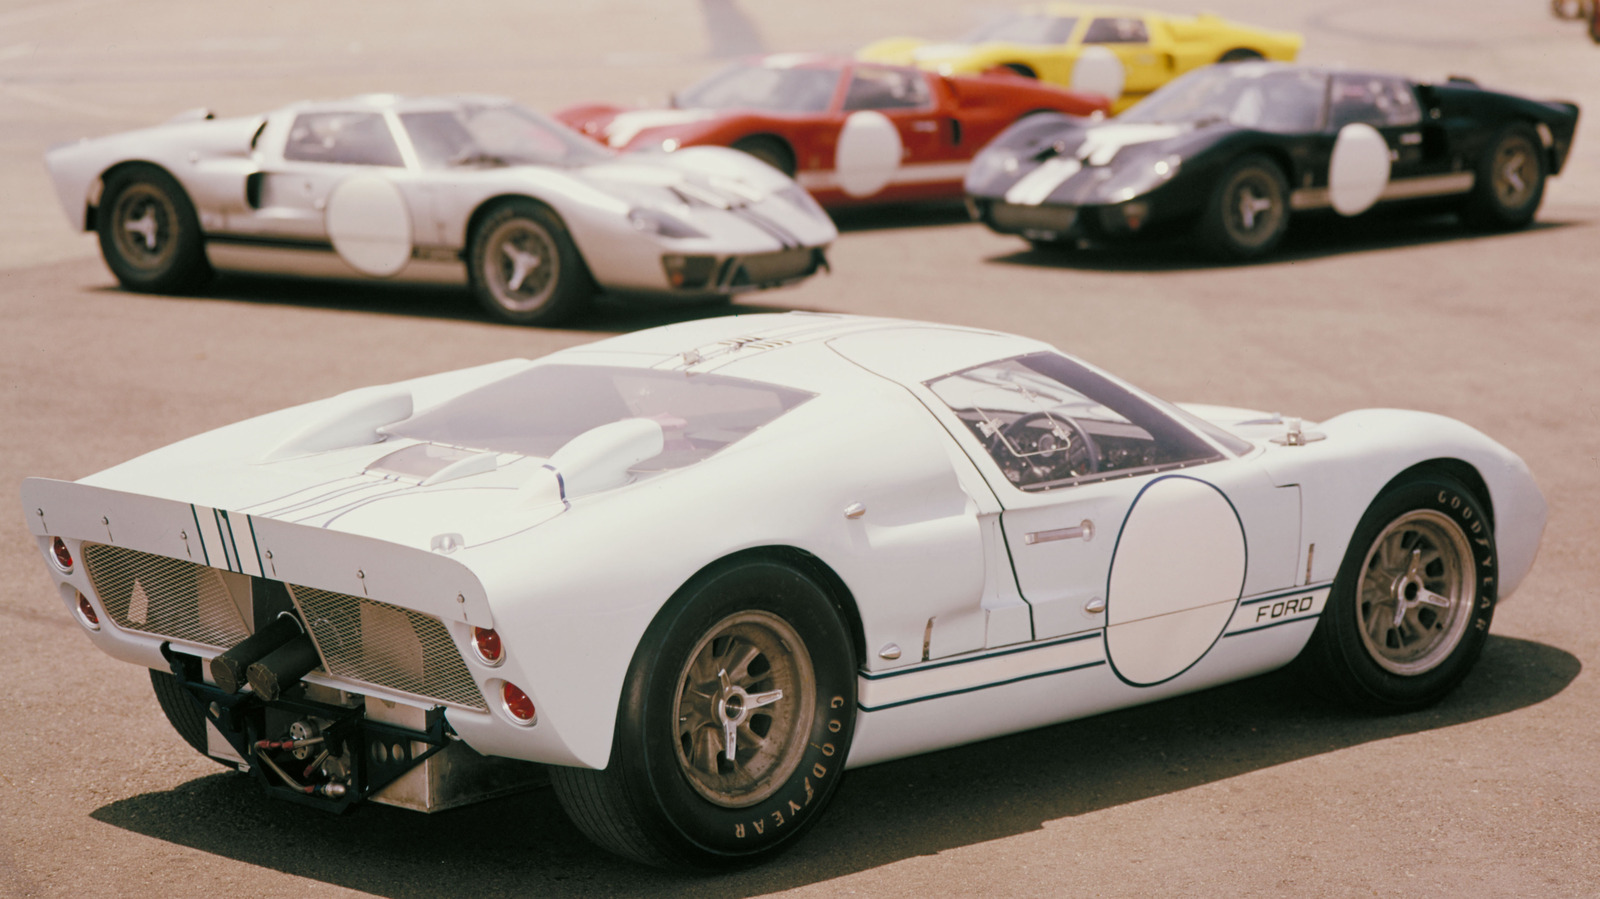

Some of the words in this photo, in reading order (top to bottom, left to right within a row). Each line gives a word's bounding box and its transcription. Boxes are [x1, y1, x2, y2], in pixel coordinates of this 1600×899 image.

[1256, 596, 1313, 622] FORD
[1437, 490, 1492, 631] GOODYEAR
[735, 696, 844, 838] GOODYEAR
